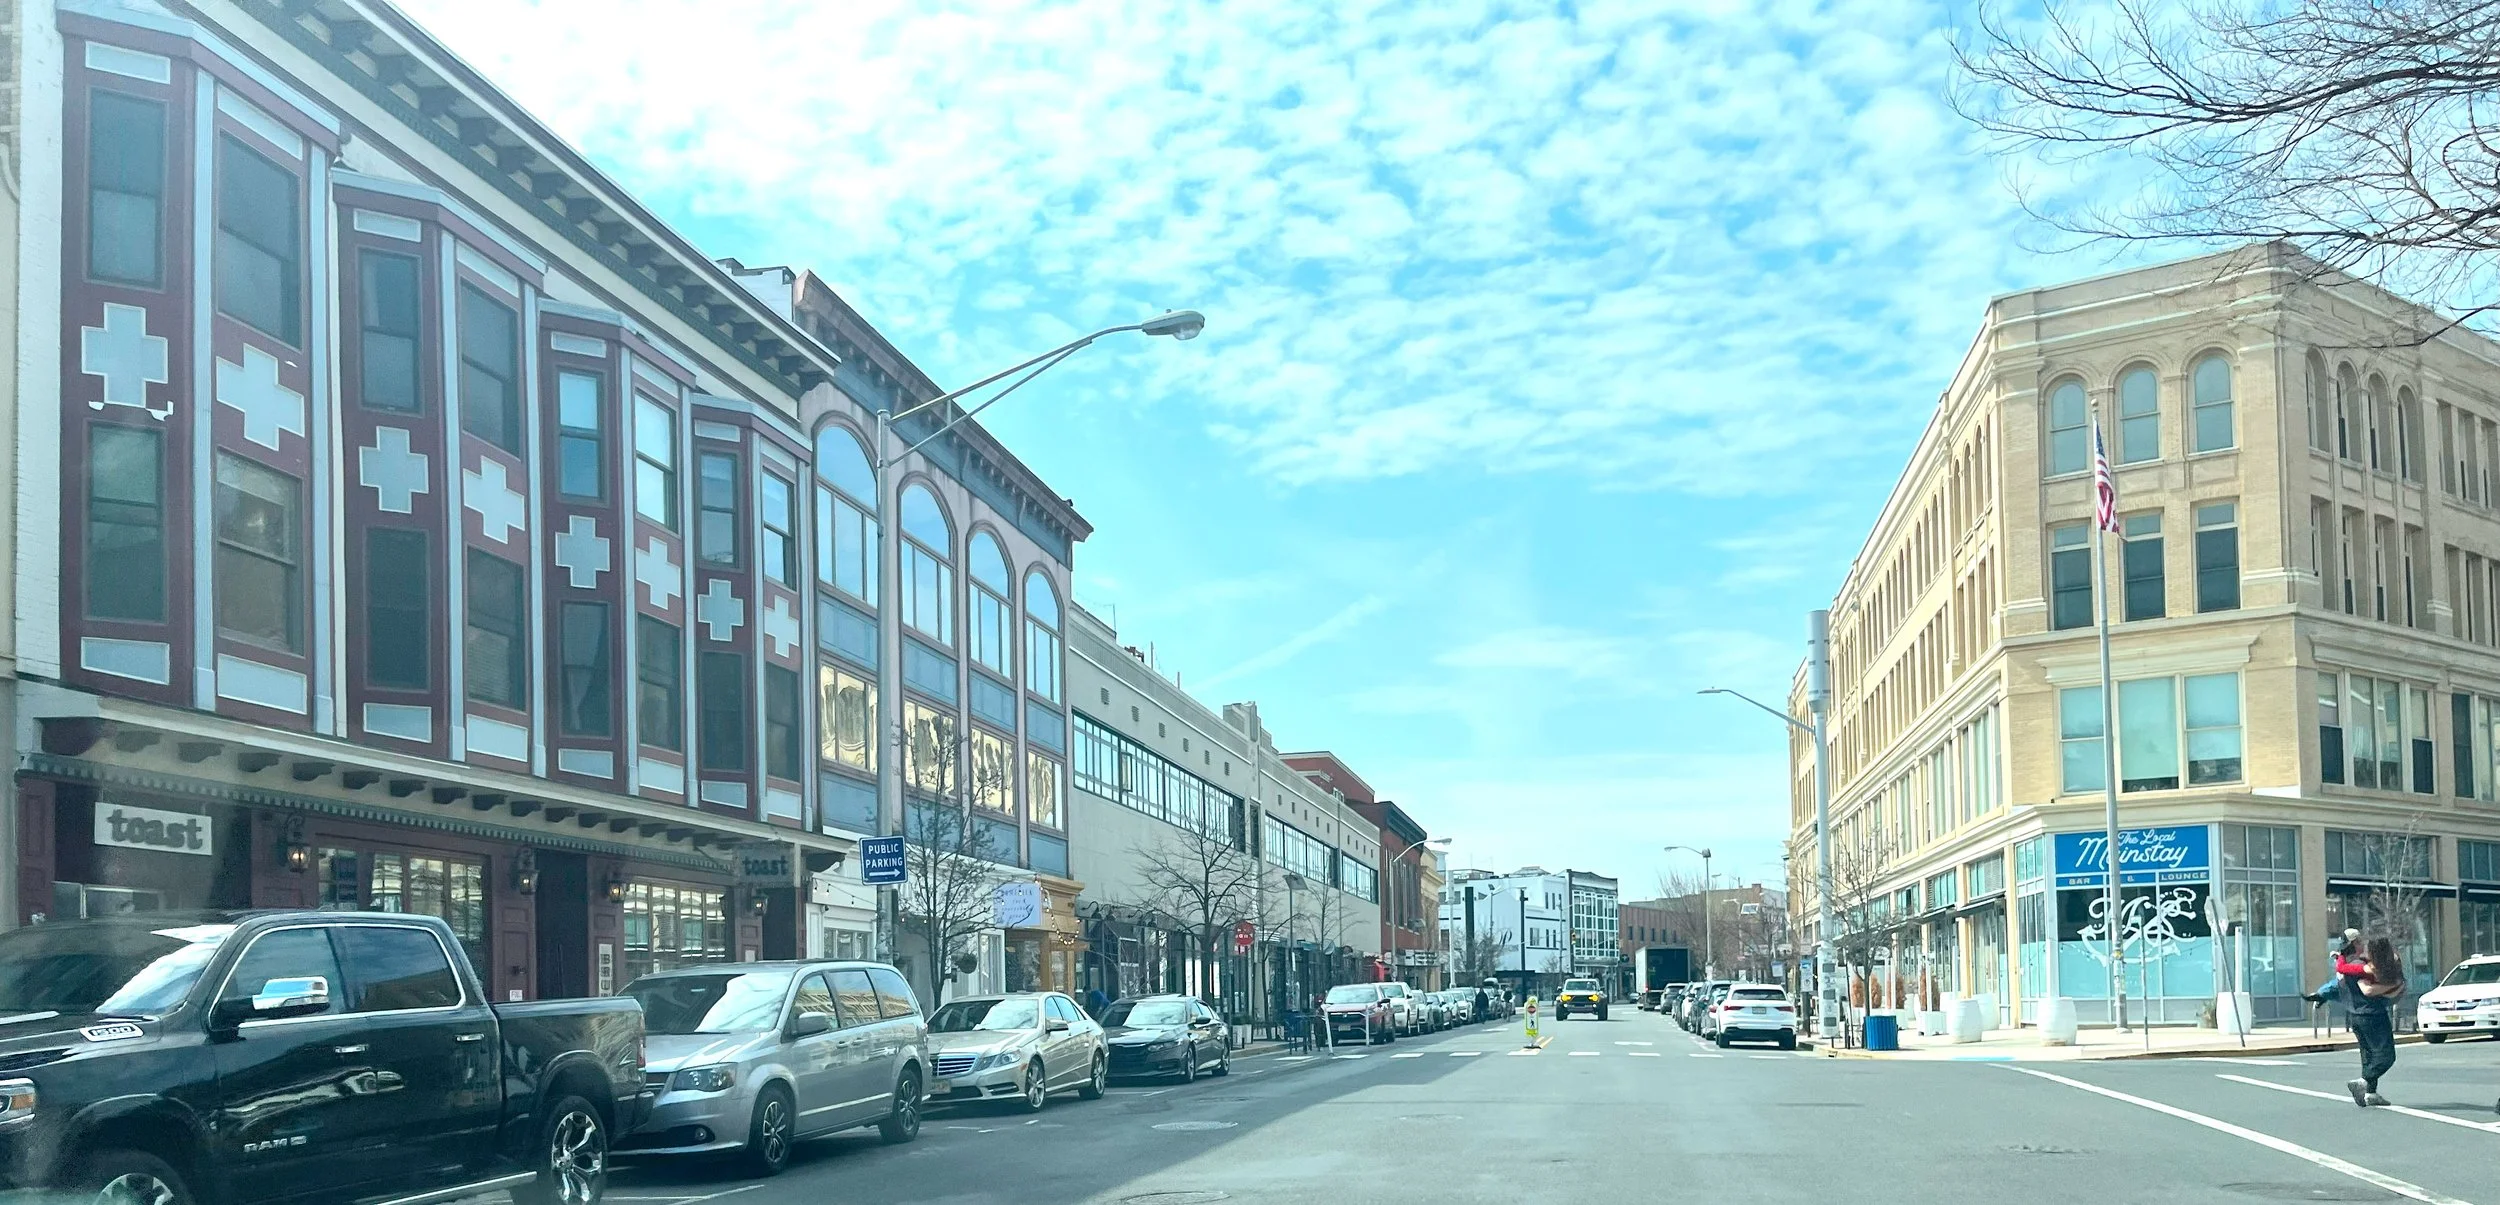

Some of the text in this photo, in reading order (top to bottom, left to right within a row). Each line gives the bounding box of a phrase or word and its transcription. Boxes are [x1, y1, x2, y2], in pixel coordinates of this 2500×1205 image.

[106, 809, 203, 850] toast
[2117, 829, 2176, 846] The Local
[868, 843, 899, 855] PUBLIC
[741, 855, 789, 876] toast
[865, 856, 903, 869] PARKING
[2068, 878, 2091, 886] BAR
[2160, 871, 2208, 881] LOUNGE
[90, 1026, 133, 1037] 1500
[244, 1138, 288, 1153] RAM
